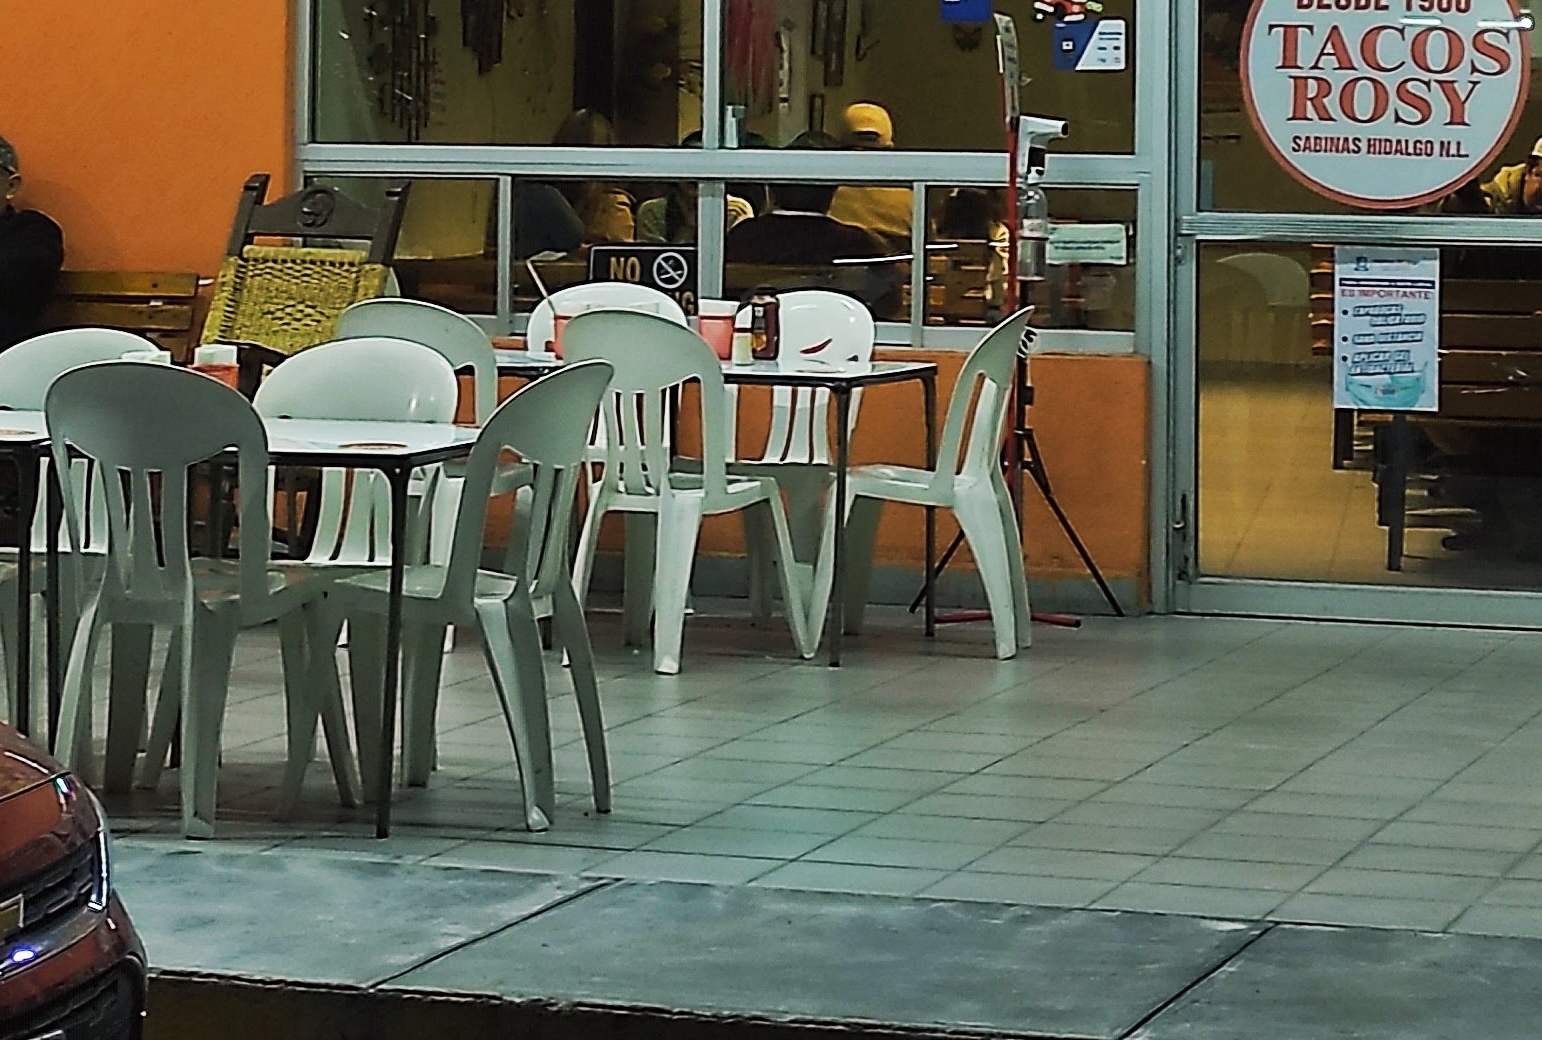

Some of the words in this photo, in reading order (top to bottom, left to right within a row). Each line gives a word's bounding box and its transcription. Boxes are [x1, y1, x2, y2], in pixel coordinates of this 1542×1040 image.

[1268, 23, 1512, 76] TACOS
[1286, 75, 1481, 127] ROSY
[1291, 134, 1362, 154] SABINAS
[1366, 137, 1435, 157] HIDALGO
[1438, 140, 1469, 158] N.L.
[609, 256, 640, 282] NO
